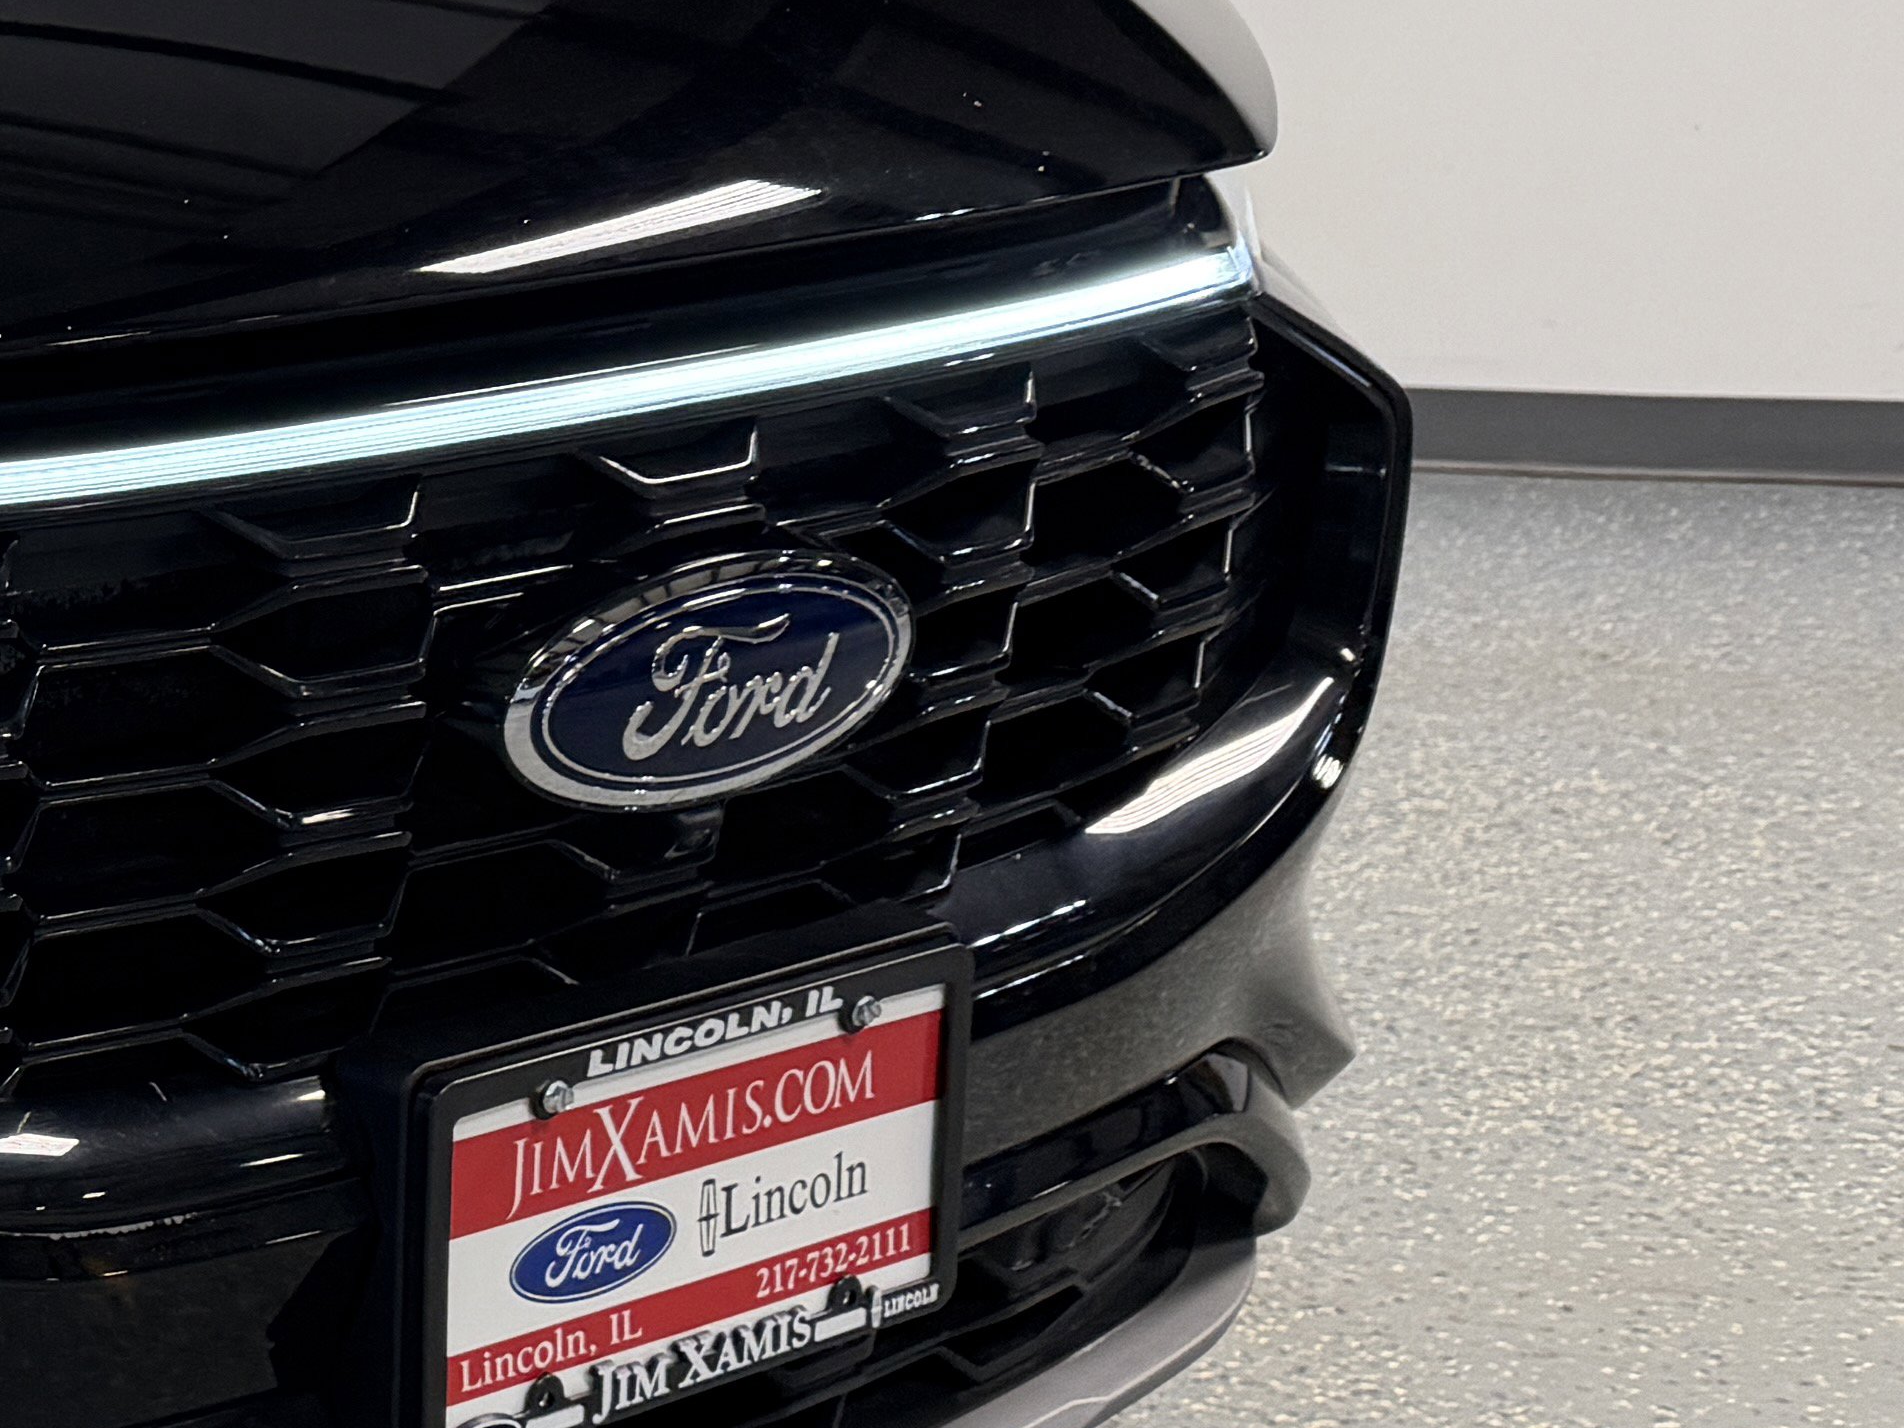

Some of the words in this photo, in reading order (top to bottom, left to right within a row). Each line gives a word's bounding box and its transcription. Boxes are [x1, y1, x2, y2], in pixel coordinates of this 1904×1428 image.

[622, 612, 840, 760] Ford
[587, 1001, 792, 1077] LINCOLN,
[805, 986, 843, 1017] IL
[506, 1050, 875, 1220] JIMXAMIS.COM
[720, 1151, 868, 1238] Lincoln
[545, 1219, 644, 1288] Ford
[756, 1223, 911, 1299] 217-732-2111
[884, 1283, 940, 1318] LINCOLN
[460, 1327, 597, 1392] Lincoln,
[609, 1309, 643, 1345] IL
[592, 1358, 671, 1424] JIM
[678, 1310, 812, 1389] XAMIS
